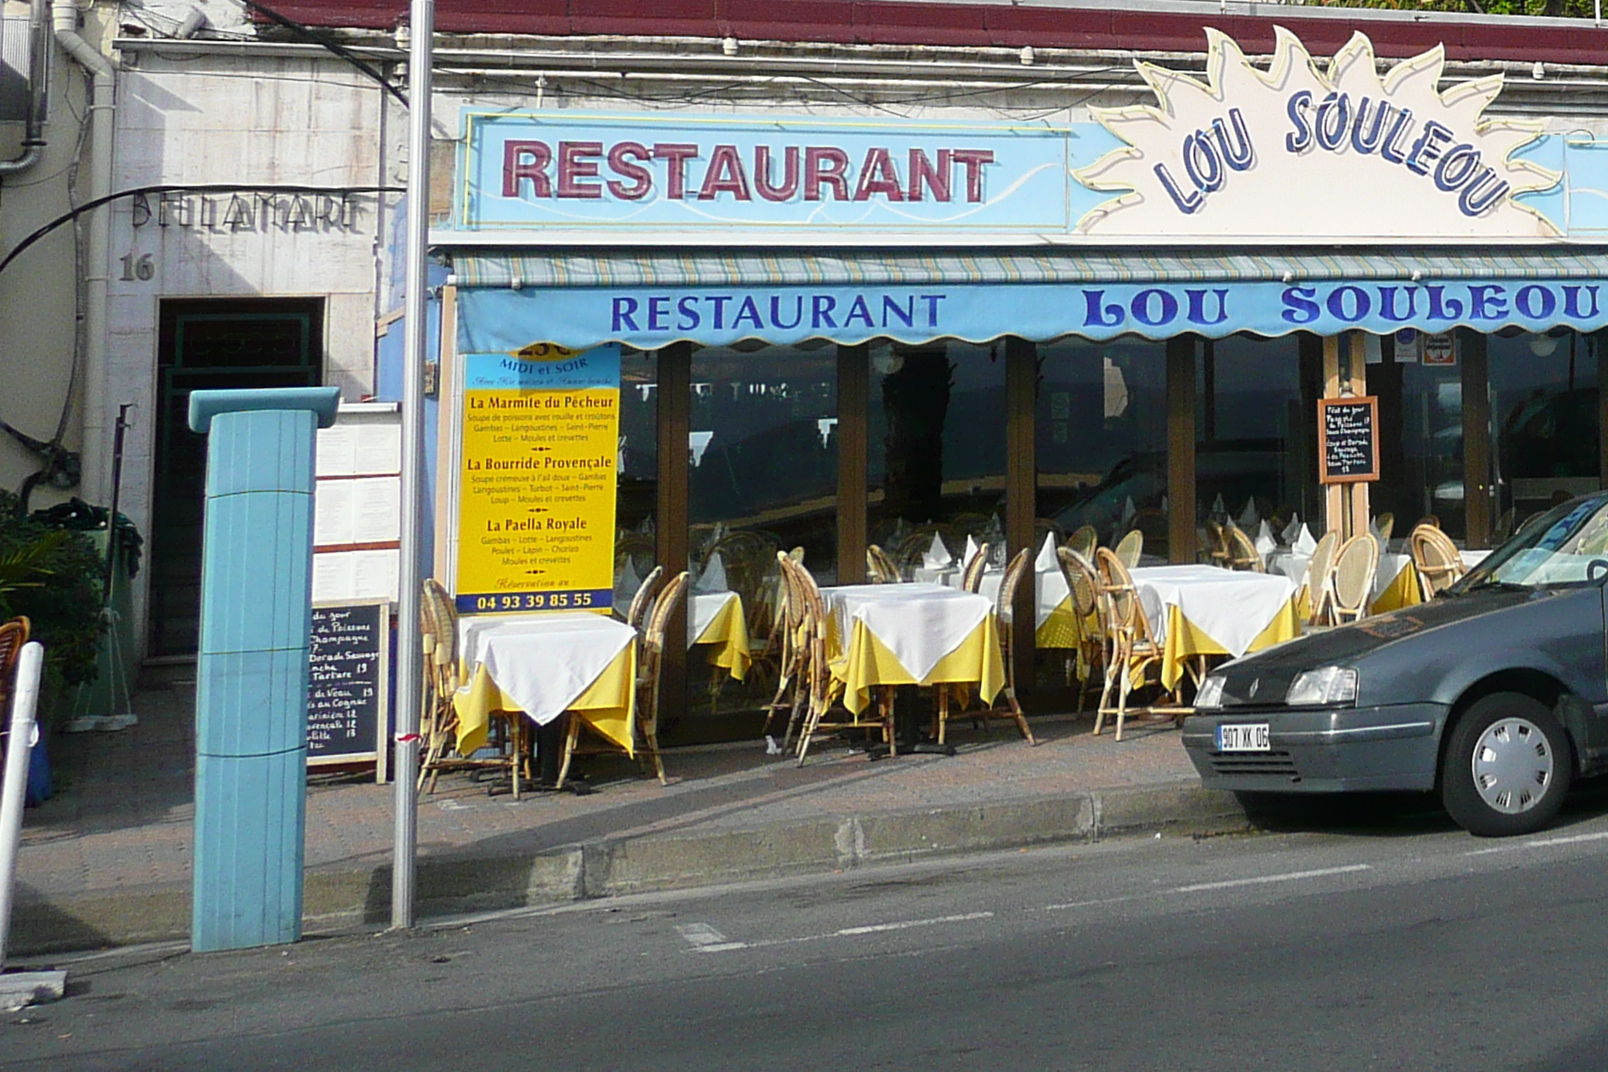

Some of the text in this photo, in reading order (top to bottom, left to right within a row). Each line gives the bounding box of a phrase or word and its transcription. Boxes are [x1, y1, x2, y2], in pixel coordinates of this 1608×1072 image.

[1154, 90, 1511, 217] LOU SOULEOU
[503, 139, 995, 203] RESTAURANT
[119, 253, 155, 282] 16
[611, 293, 947, 333] RESTAURANT
[1082, 287, 1230, 328] LOU
[1280, 284, 1601, 325] SOULEOU
[499, 357, 589, 375] MIDI et SOIR
[470, 395, 614, 409] La Marmite du Pêcheur
[467, 413, 491, 423] Soupe
[491, 413, 502, 422] de
[467, 455, 612, 471] La Bourride Provençale
[471, 475, 494, 485] Soupe
[473, 485, 521, 496] Langoustines
[490, 496, 510, 507] Loup
[487, 516, 589, 533] La Paella Royale
[477, 593, 592, 610] 04 93 39 85 55
[1222, 727, 1239, 748] 907
[1256, 727, 1268, 748] 06
